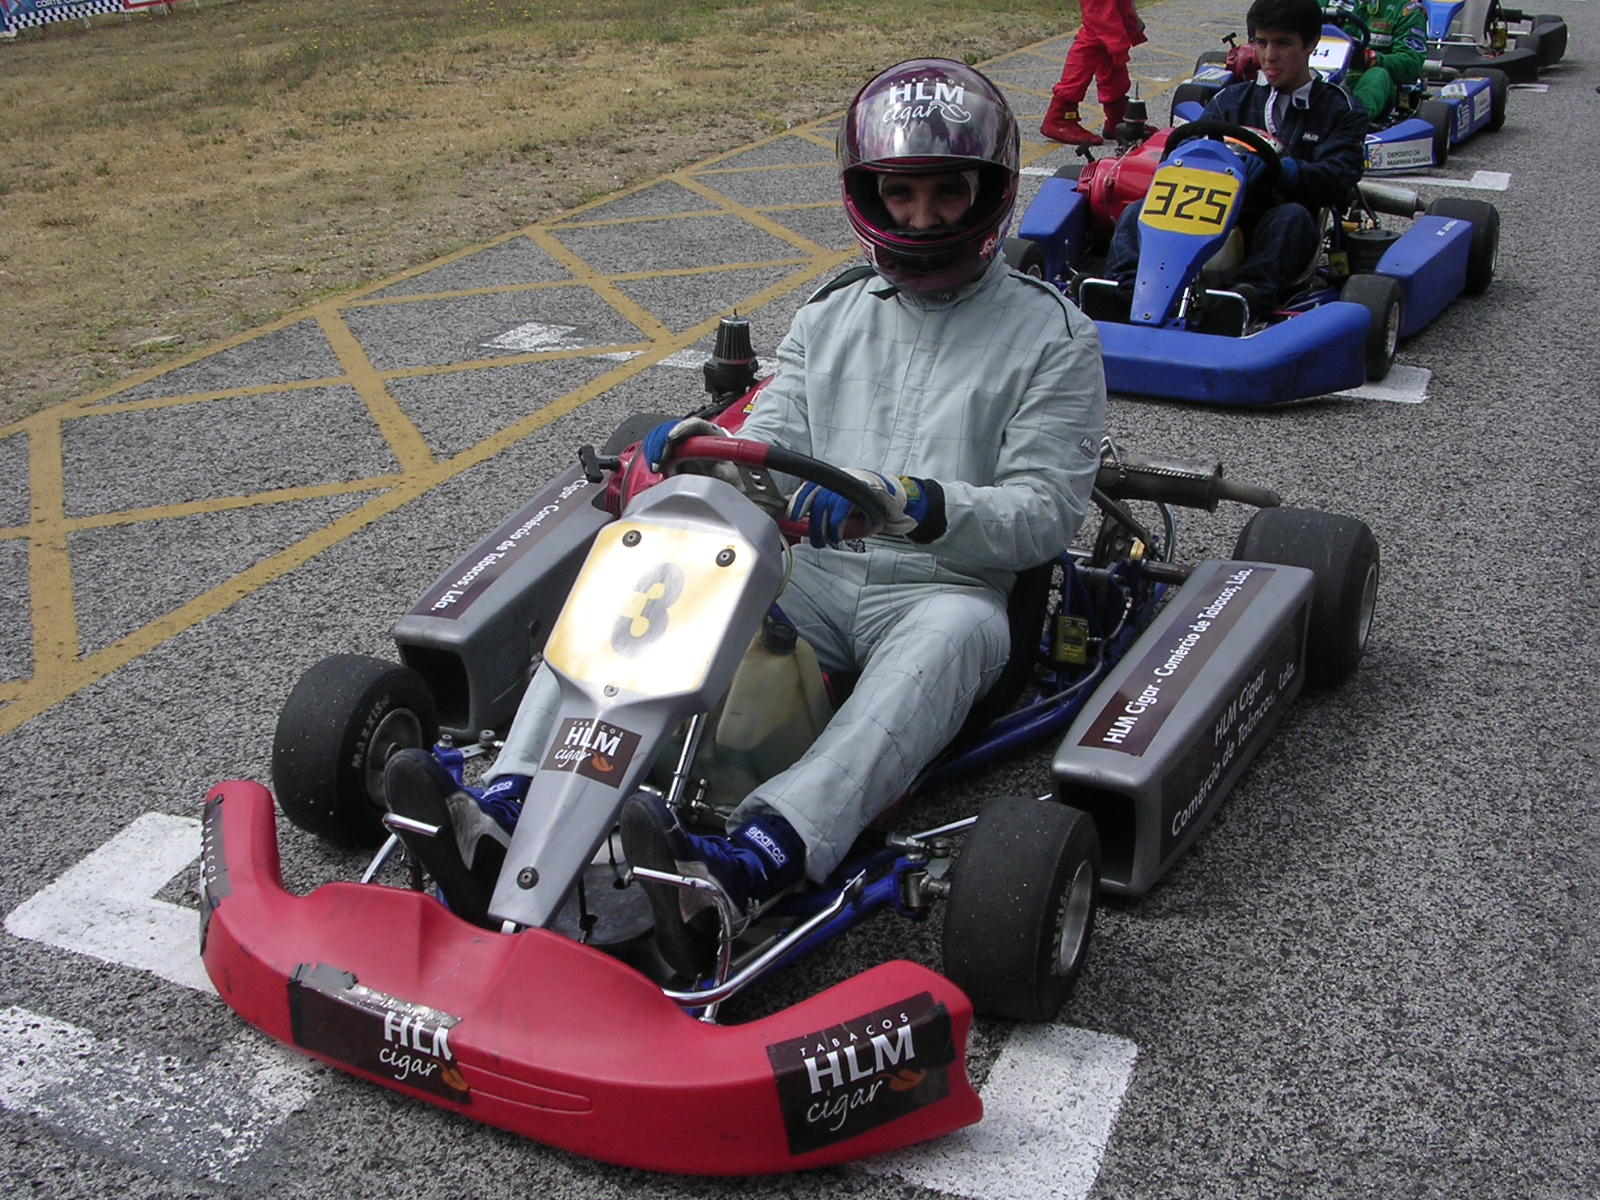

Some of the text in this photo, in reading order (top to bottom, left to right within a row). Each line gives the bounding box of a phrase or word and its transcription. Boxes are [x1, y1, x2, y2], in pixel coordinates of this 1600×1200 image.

[888, 82, 965, 105] HLM
[883, 102, 938, 129] cigar
[1143, 180, 1232, 226] 325
[496, 540, 518, 552] de
[452, 551, 505, 588] Tabacos,
[1226, 568, 1254, 585] Lda.
[431, 588, 464, 611] Lda.
[611, 562, 685, 659] 3
[1197, 585, 1242, 620] Tabacos,
[1189, 619, 1211, 633] de
[1154, 631, 1201, 677] Comércio
[1125, 684, 1160, 714] Cigar
[1215, 668, 1266, 746] HLM Cigar
[564, 726, 621, 757] HLM
[572, 721, 624, 738] TABCOS
[1103, 715, 1138, 744] HLM
[554, 745, 592, 768] cigar
[1172, 760, 1221, 837] Comércio
[1222, 740, 1235, 767] de
[748, 826, 786, 864] sparco
[800, 1012, 909, 1057] TABACOS
[379, 1043, 437, 1080] cigar
[804, 1024, 916, 1094] HLM
[807, 1080, 884, 1131] cigar
